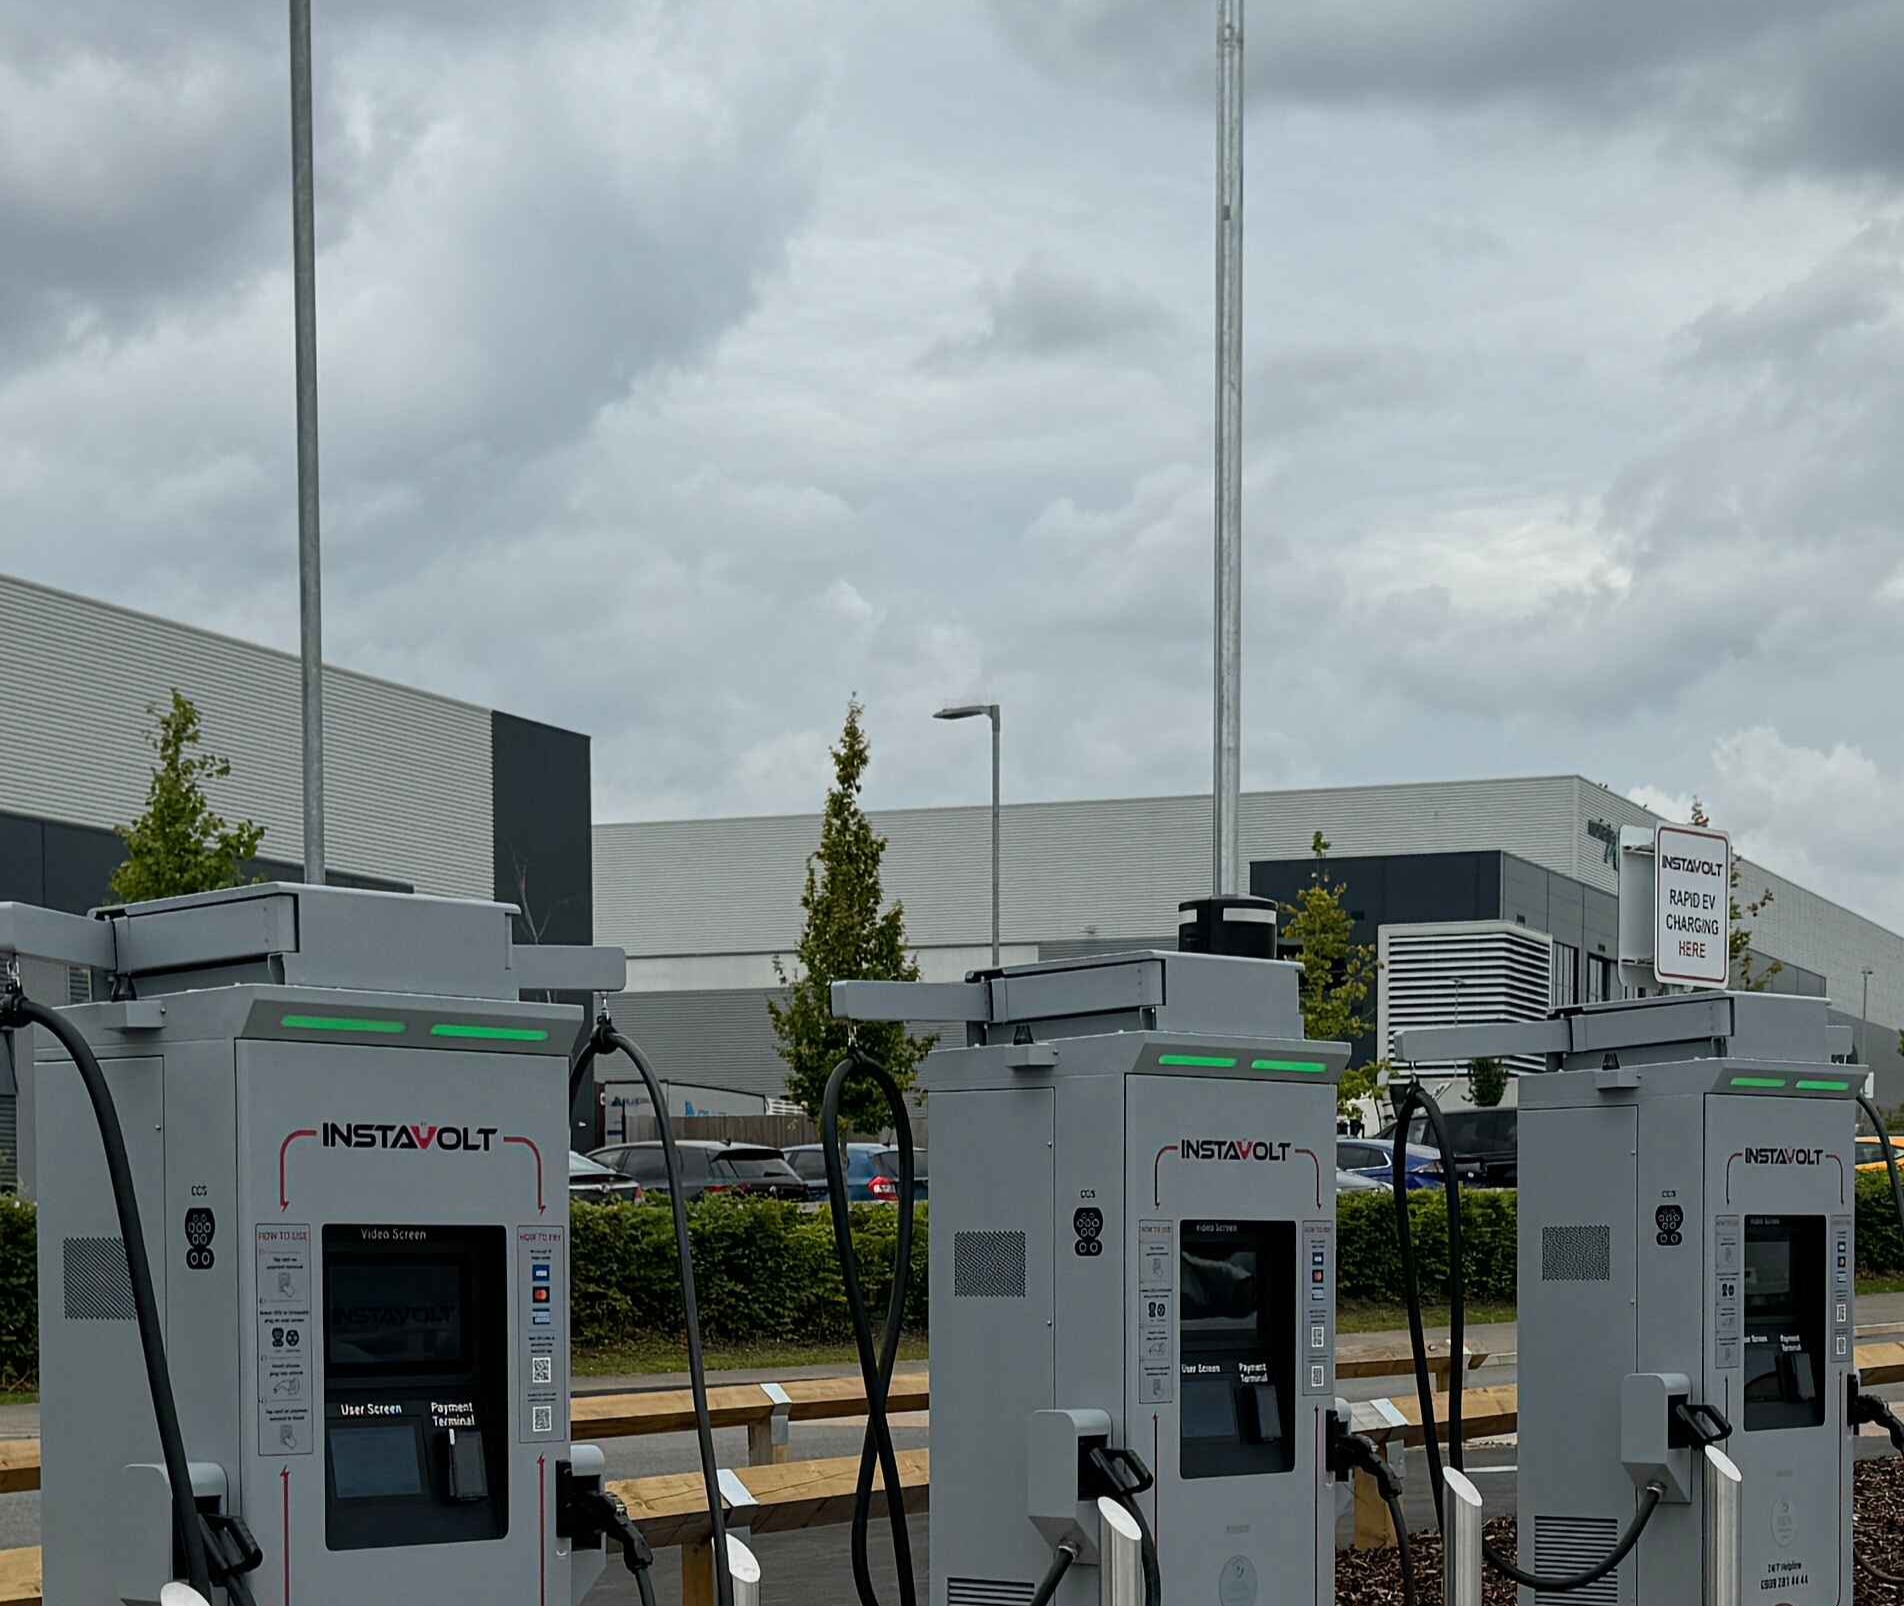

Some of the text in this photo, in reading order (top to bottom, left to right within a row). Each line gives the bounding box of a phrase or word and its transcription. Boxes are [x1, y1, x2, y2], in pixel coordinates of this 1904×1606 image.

[1661, 855, 1724, 877] INSTAVOLT
[1669, 889, 1716, 910] RAPID EV
[1666, 913, 1719, 936] CHARGING
[1678, 940, 1707, 958] HERE
[322, 1122, 499, 1152] INSTAVOLT
[1181, 1138, 1291, 1162] INSTAVOLT
[1744, 1147, 1824, 1166] INSTAVOLT
[360, 1228, 427, 1241] Video Screen
[340, 1402, 403, 1416] User Screen
[430, 1401, 473, 1417] Payment
[432, 1413, 476, 1428] Terminal
